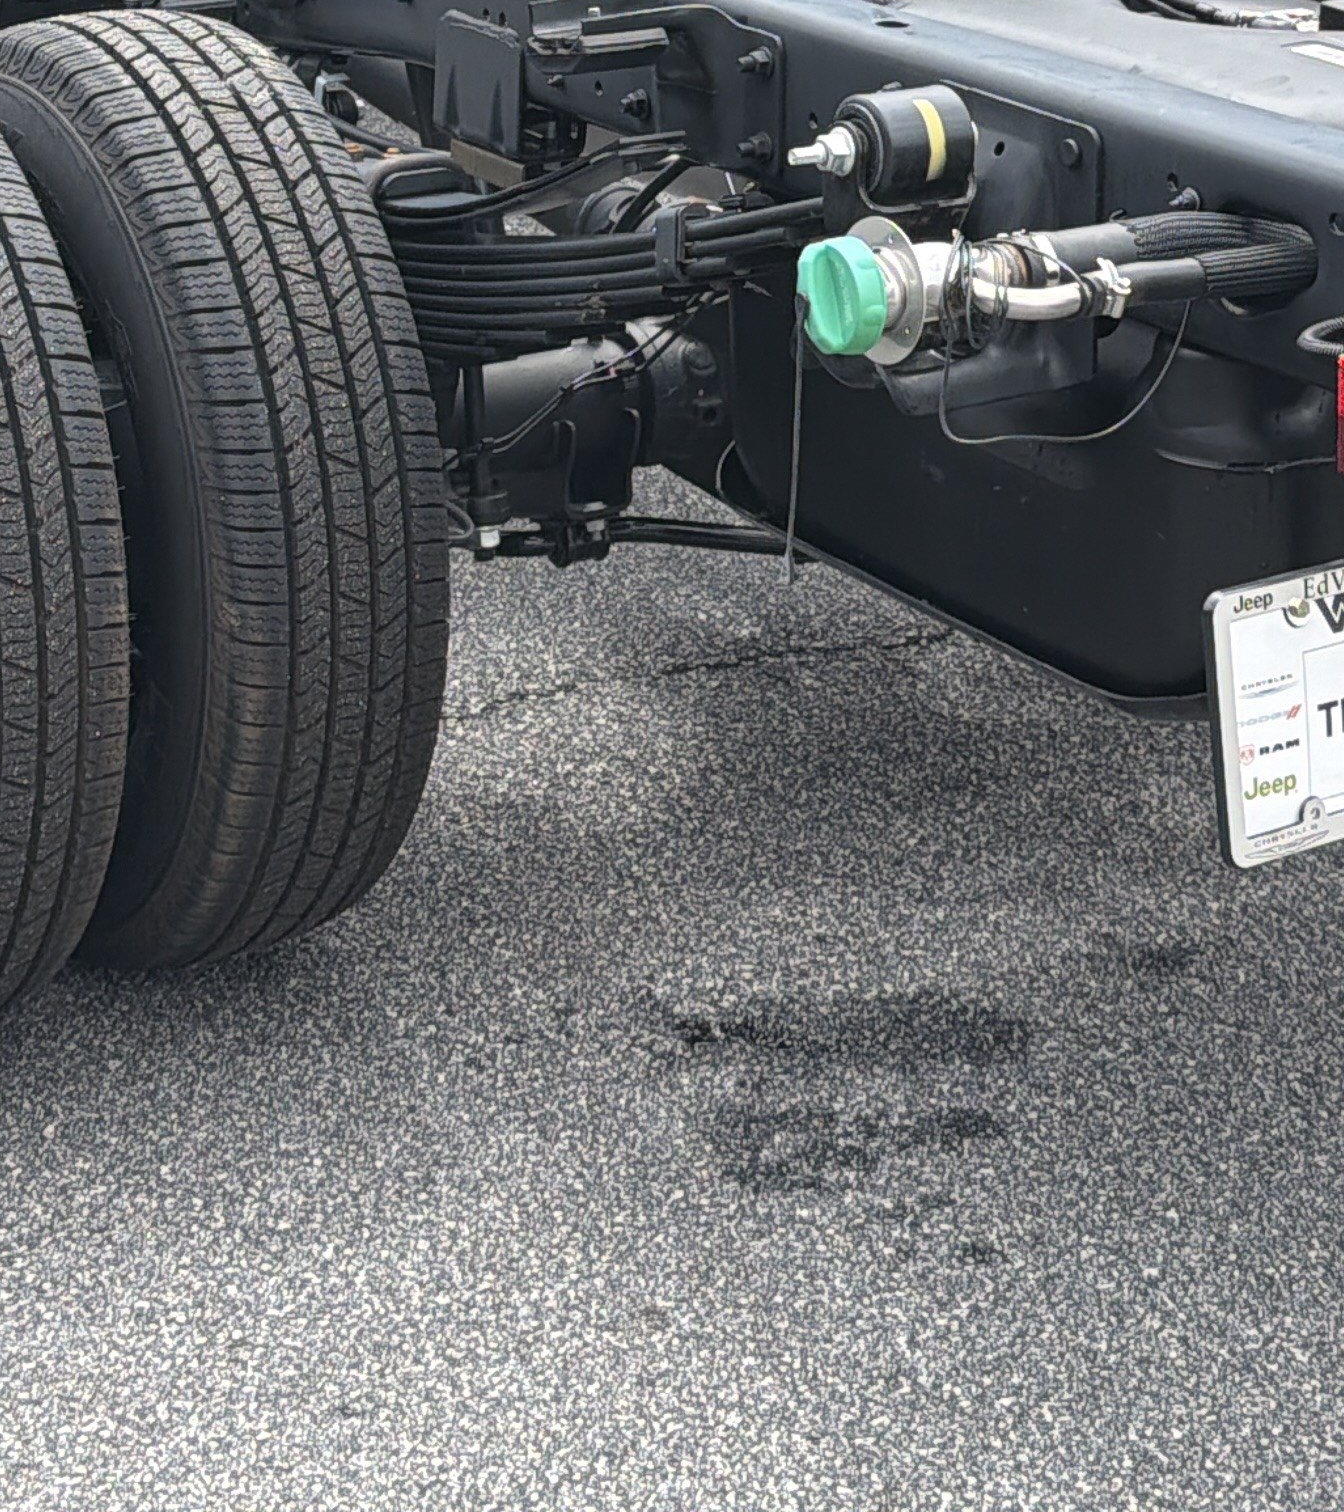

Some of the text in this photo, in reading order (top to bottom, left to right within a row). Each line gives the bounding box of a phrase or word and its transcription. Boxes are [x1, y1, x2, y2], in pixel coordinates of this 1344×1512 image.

[1233, 592, 1274, 613] Jeep
[1259, 738, 1300, 756] RAM
[1244, 773, 1297, 800] Jeep
